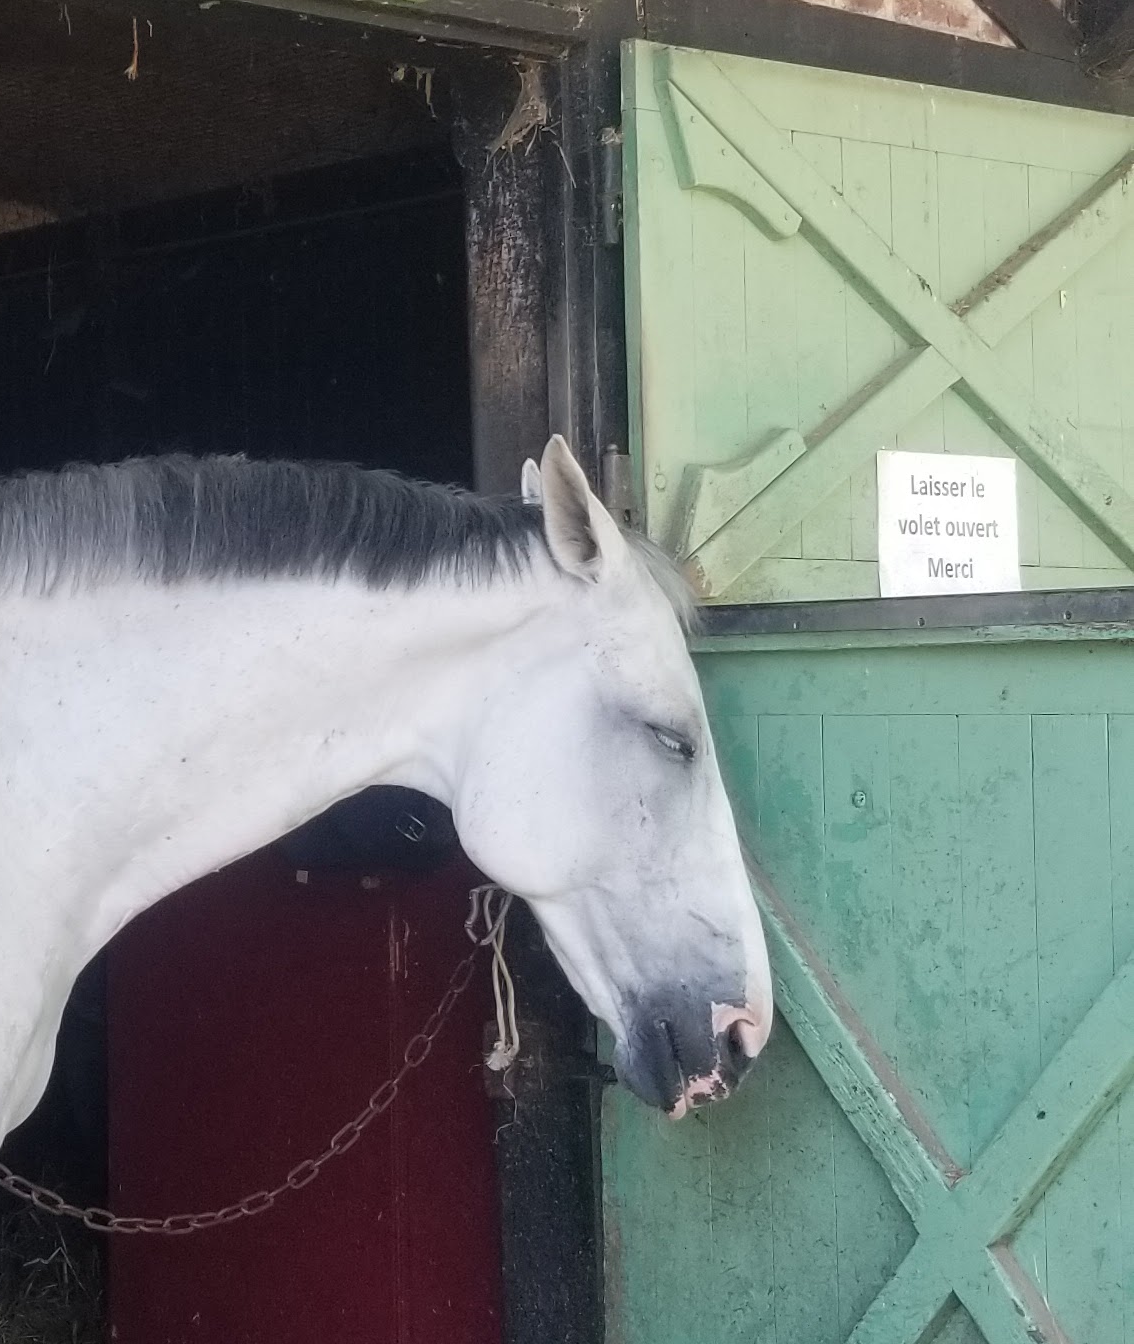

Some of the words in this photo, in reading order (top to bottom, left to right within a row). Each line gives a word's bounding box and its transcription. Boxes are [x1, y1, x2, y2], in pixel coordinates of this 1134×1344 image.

[910, 474, 966, 497] Laisser
[971, 476, 985, 498] le
[898, 513, 941, 536] volet
[945, 519, 999, 538] ouvert
[927, 557, 974, 579] Merci
